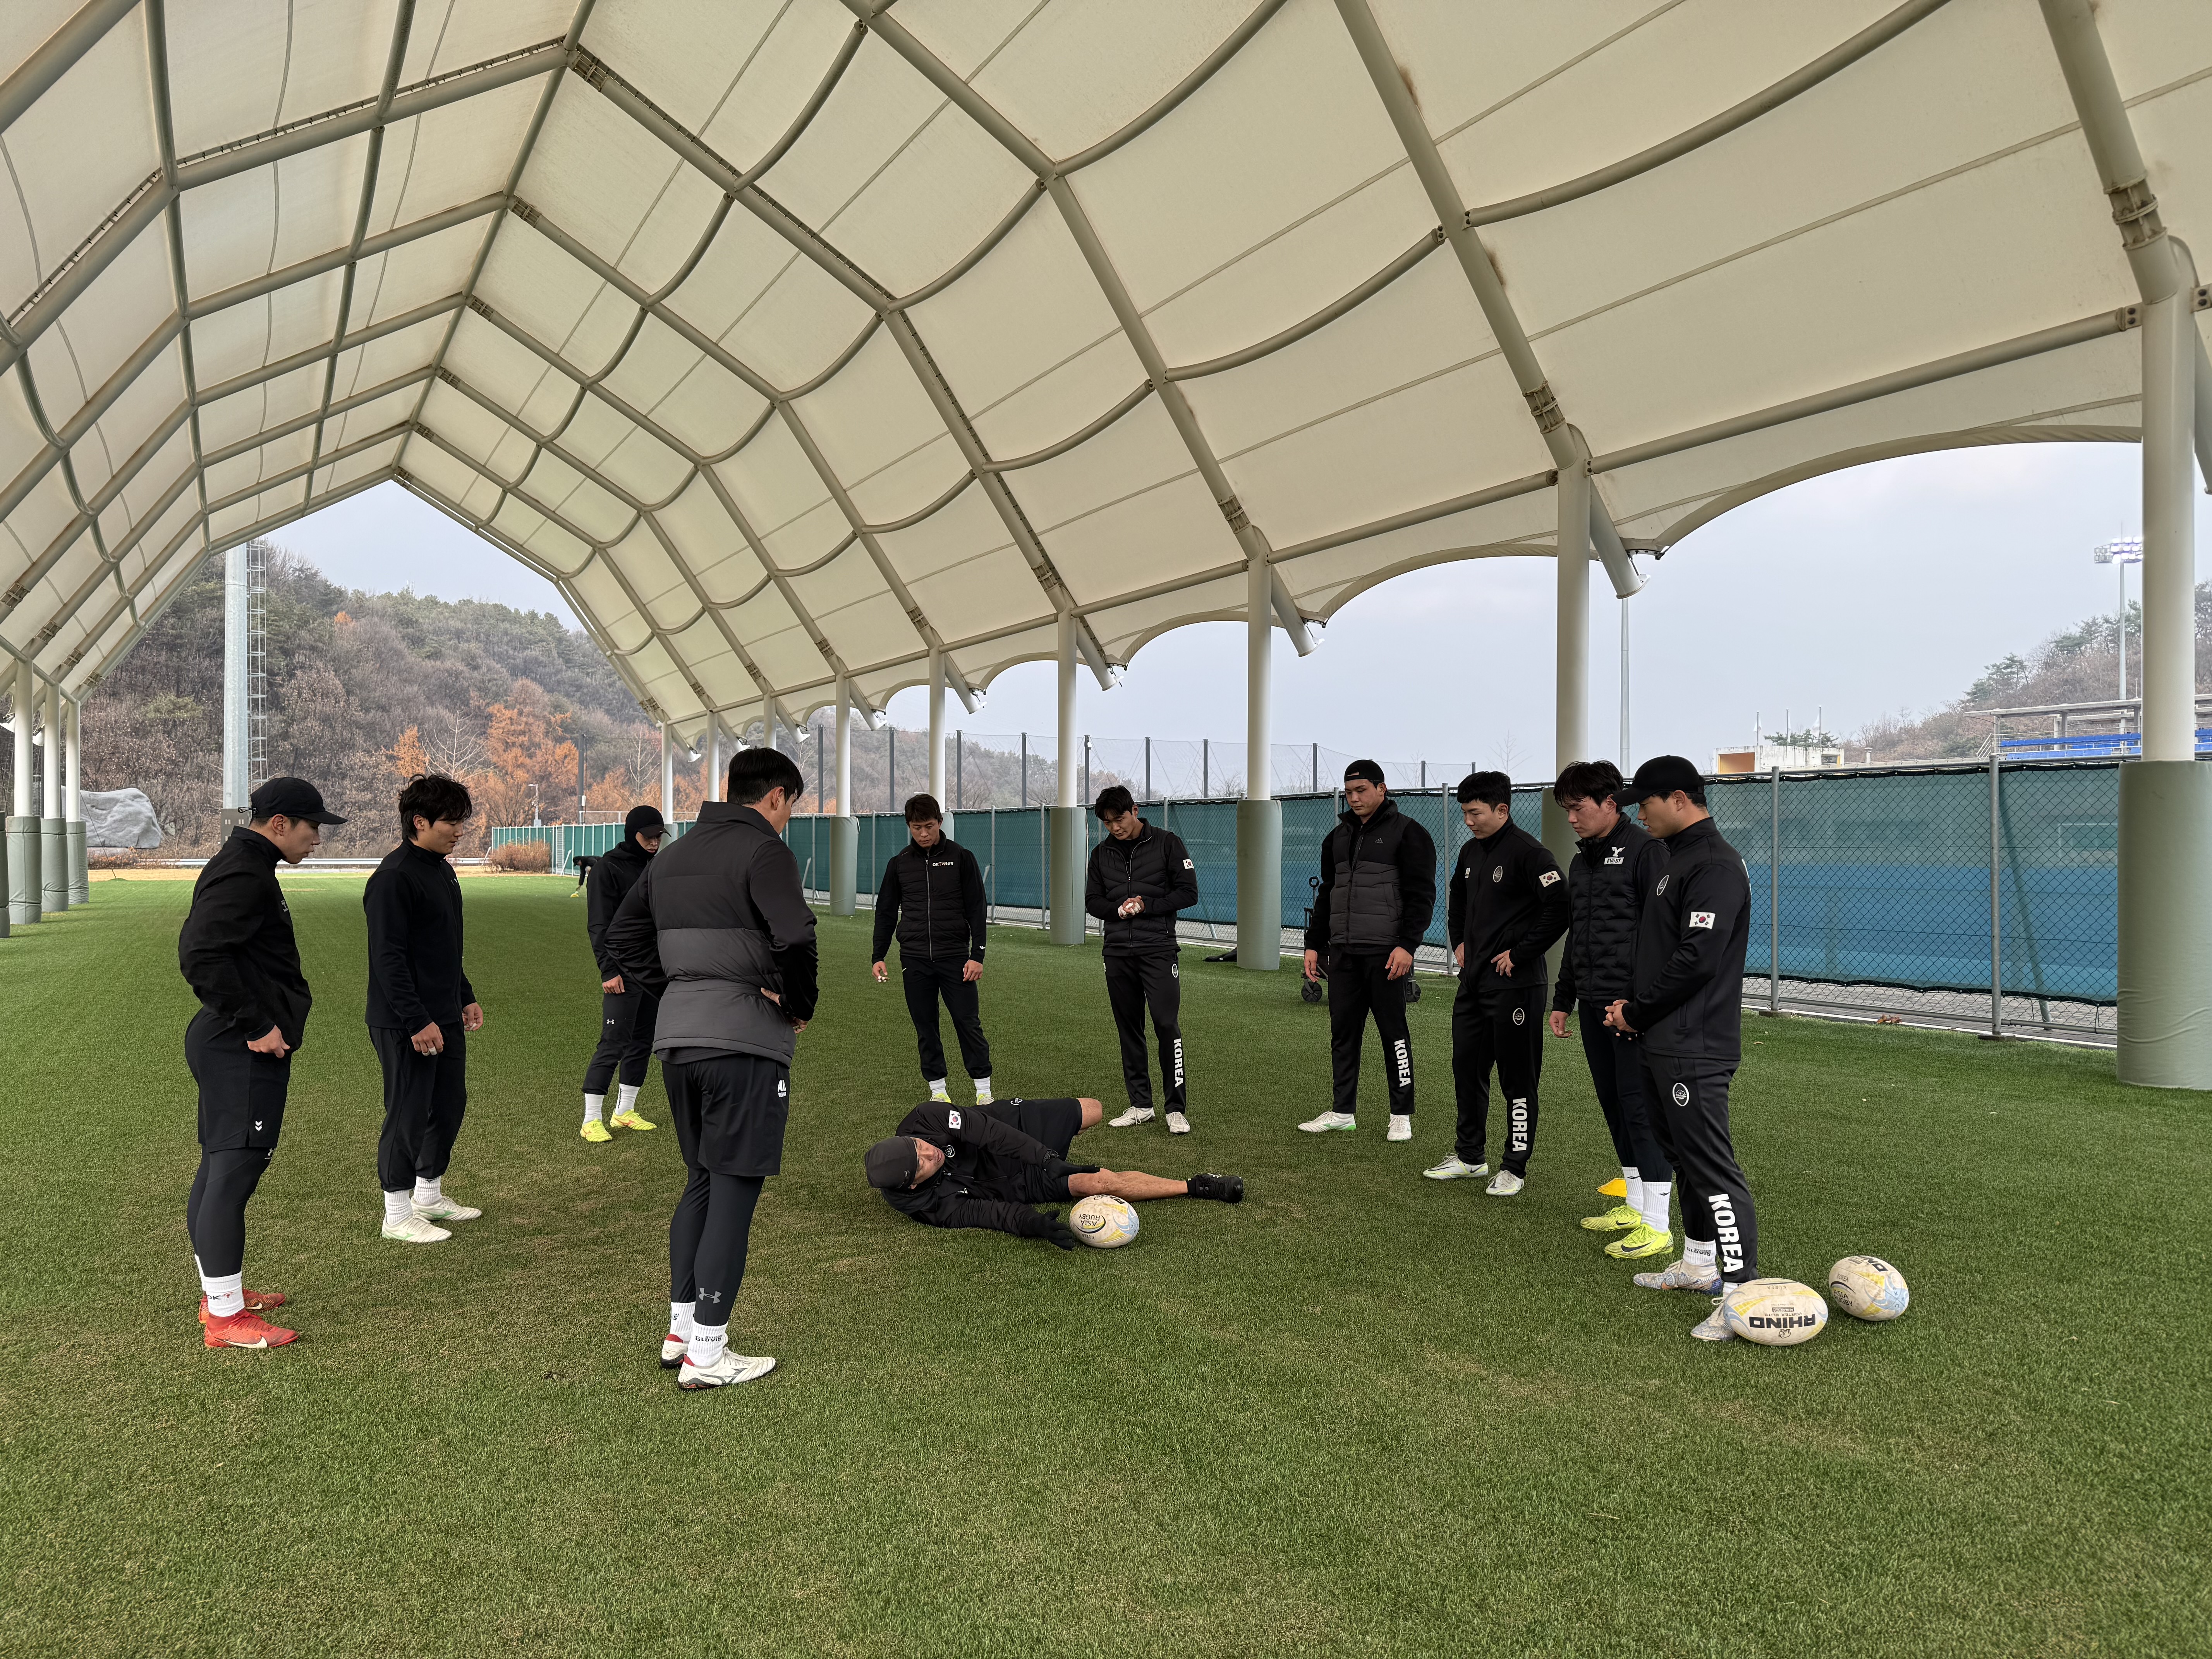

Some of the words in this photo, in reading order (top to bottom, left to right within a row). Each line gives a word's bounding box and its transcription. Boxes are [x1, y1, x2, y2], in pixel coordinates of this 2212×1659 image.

[1174, 1038, 1183, 1087] KOREA
[1394, 1039, 1411, 1087] KOREA
[1512, 1098, 1527, 1151] KOREA
[1708, 1194, 1744, 1273] KOREA
[1834, 1289, 1849, 1300] ASIA
[1749, 1314, 1816, 1329] RHINO
